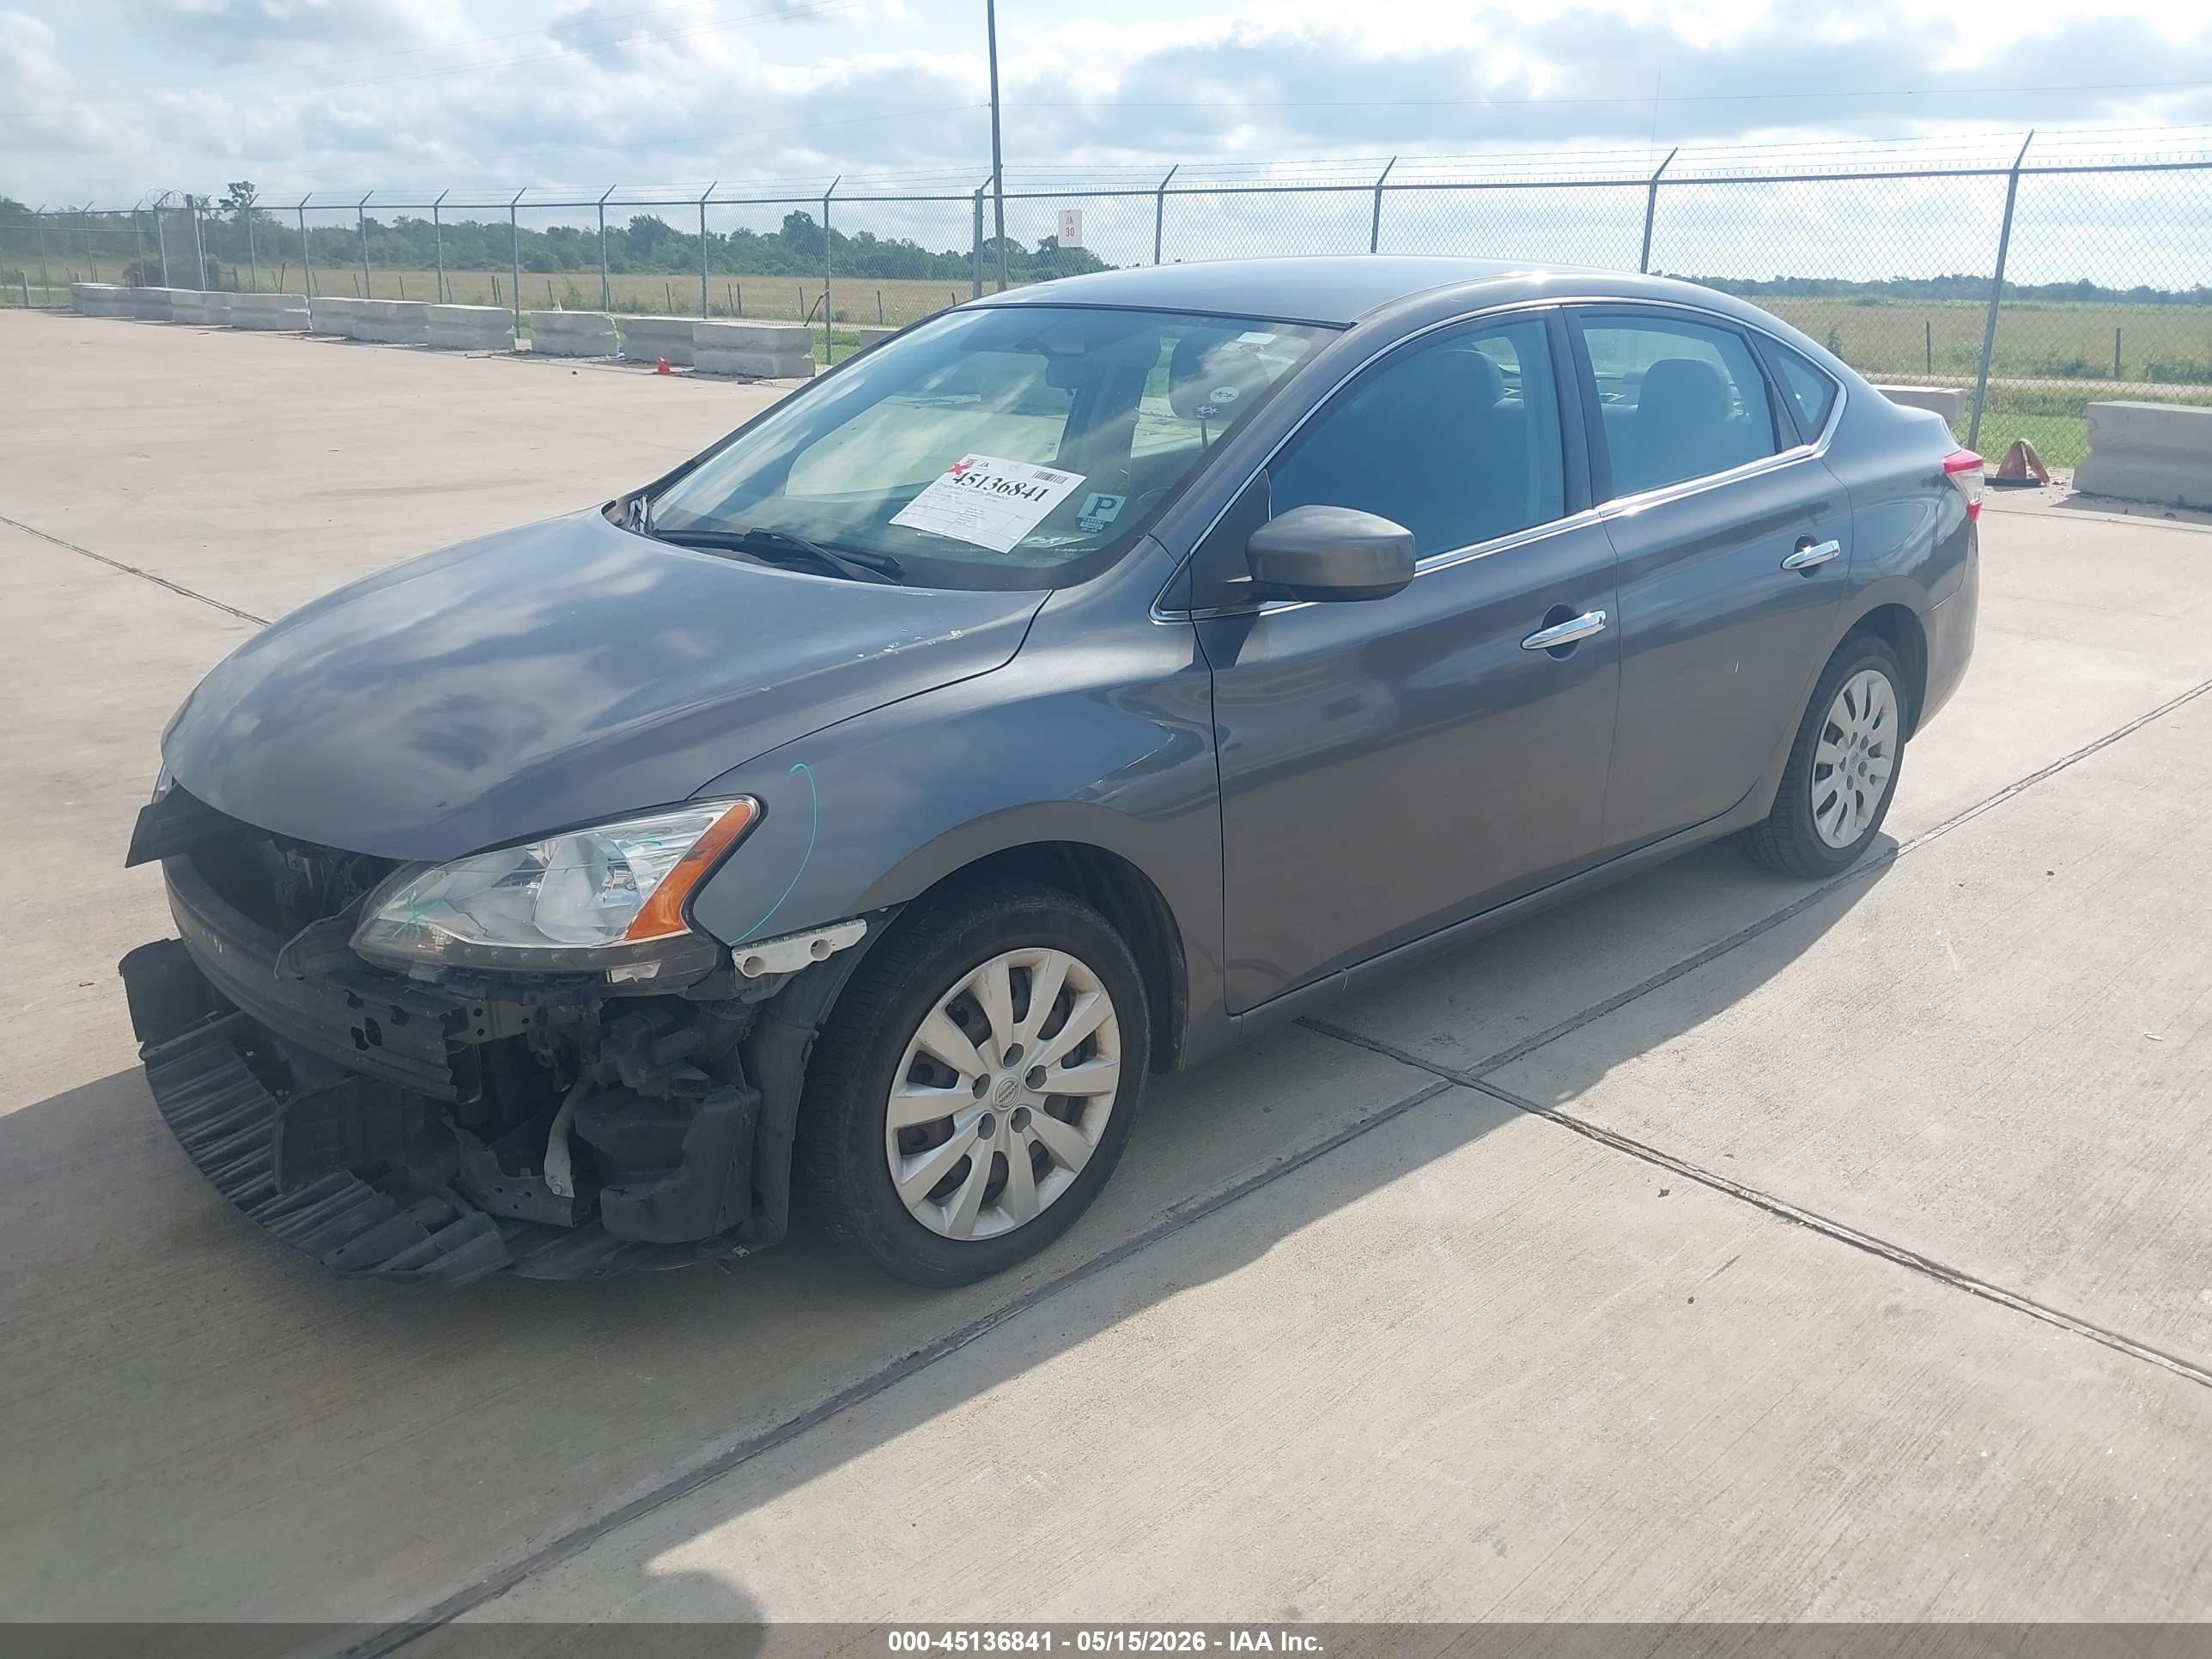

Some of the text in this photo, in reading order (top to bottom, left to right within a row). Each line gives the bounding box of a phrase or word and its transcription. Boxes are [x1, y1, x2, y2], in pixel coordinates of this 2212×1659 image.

[1065, 227, 1074, 237] 30
[952, 471, 1050, 502] 45136841
[1086, 496, 1117, 517] P
